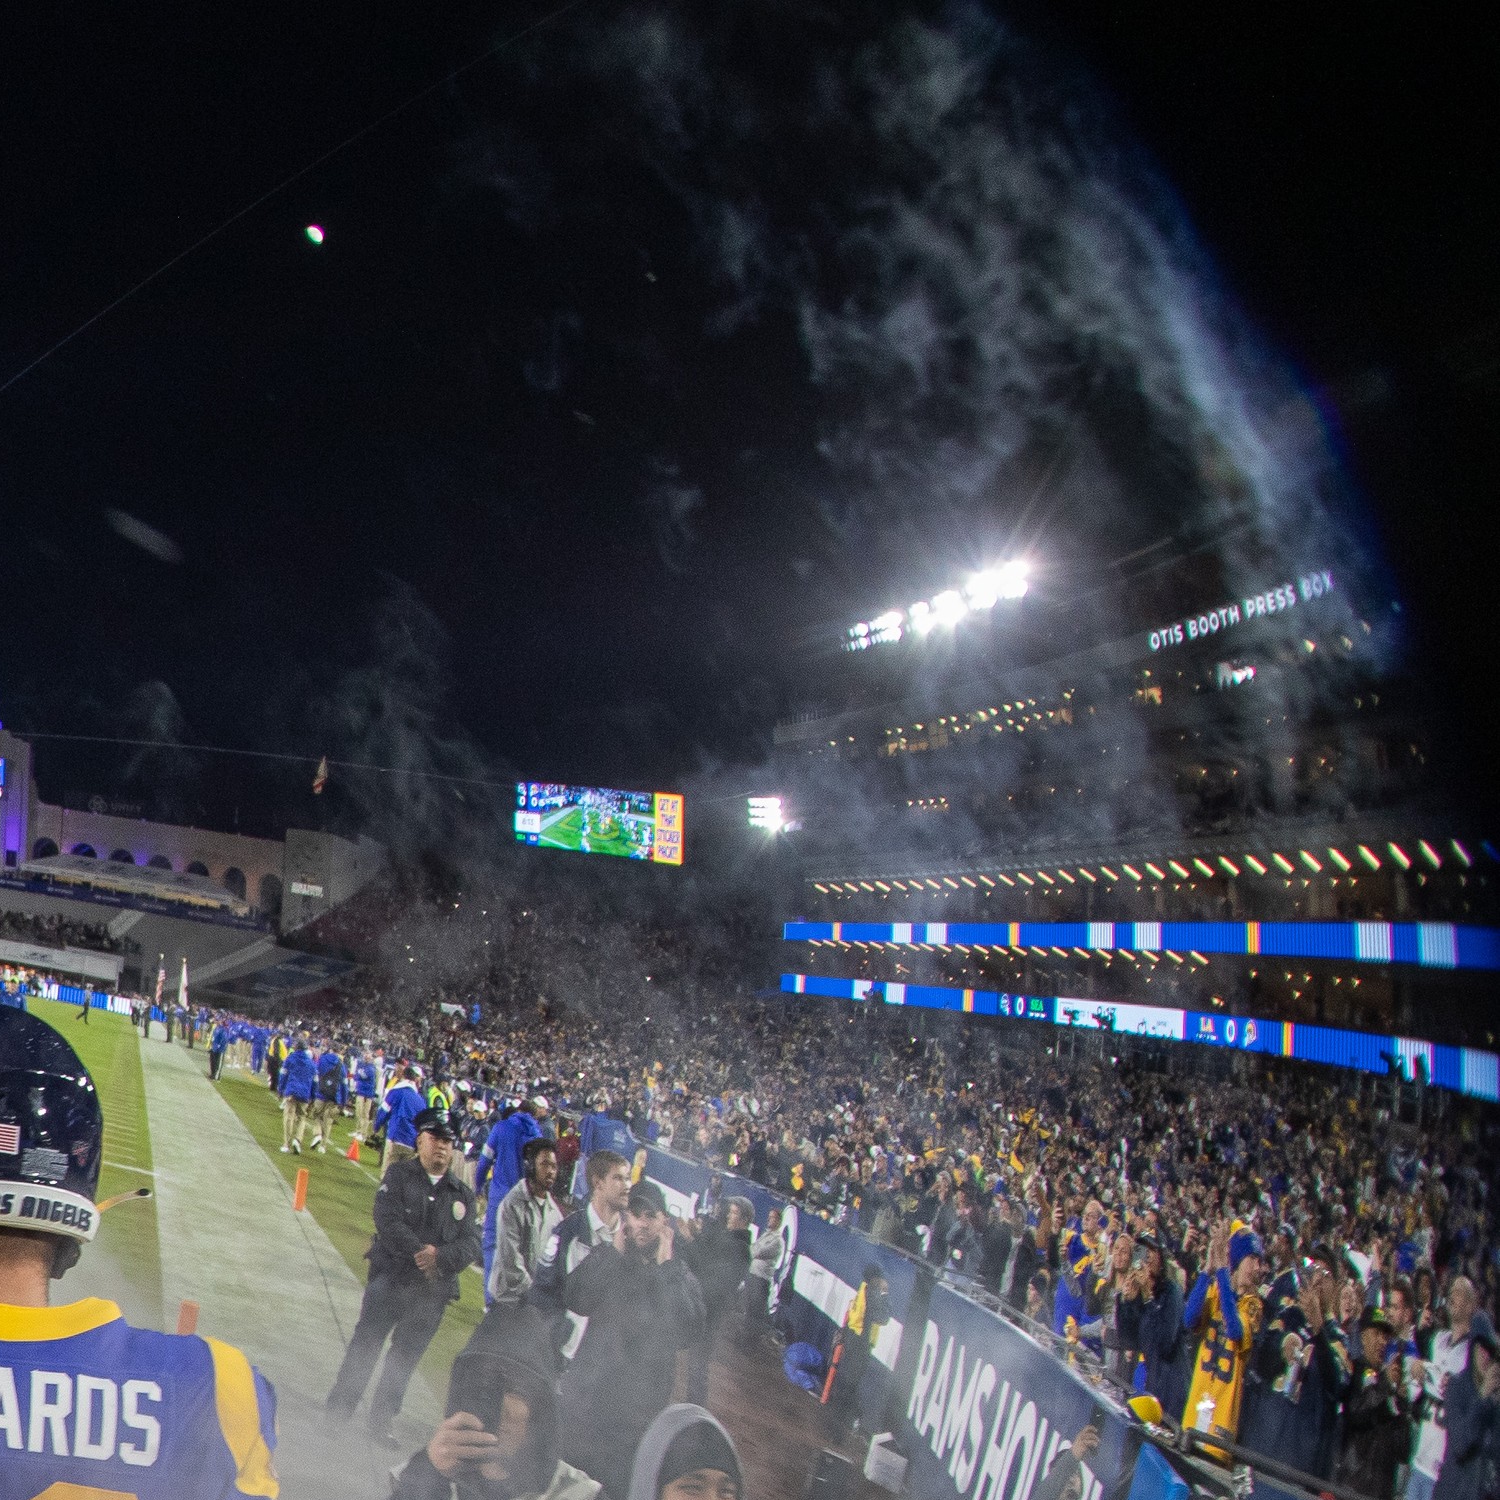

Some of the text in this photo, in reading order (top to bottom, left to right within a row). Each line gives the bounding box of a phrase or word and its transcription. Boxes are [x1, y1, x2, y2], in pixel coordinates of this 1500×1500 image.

[1149, 624, 1184, 652] OTIS
[1186, 604, 1240, 640] BOOTH
[1242, 582, 1297, 620] PRESS
[18, 1195, 93, 1232] ANGELES
[907, 1318, 998, 1495] RAMS
